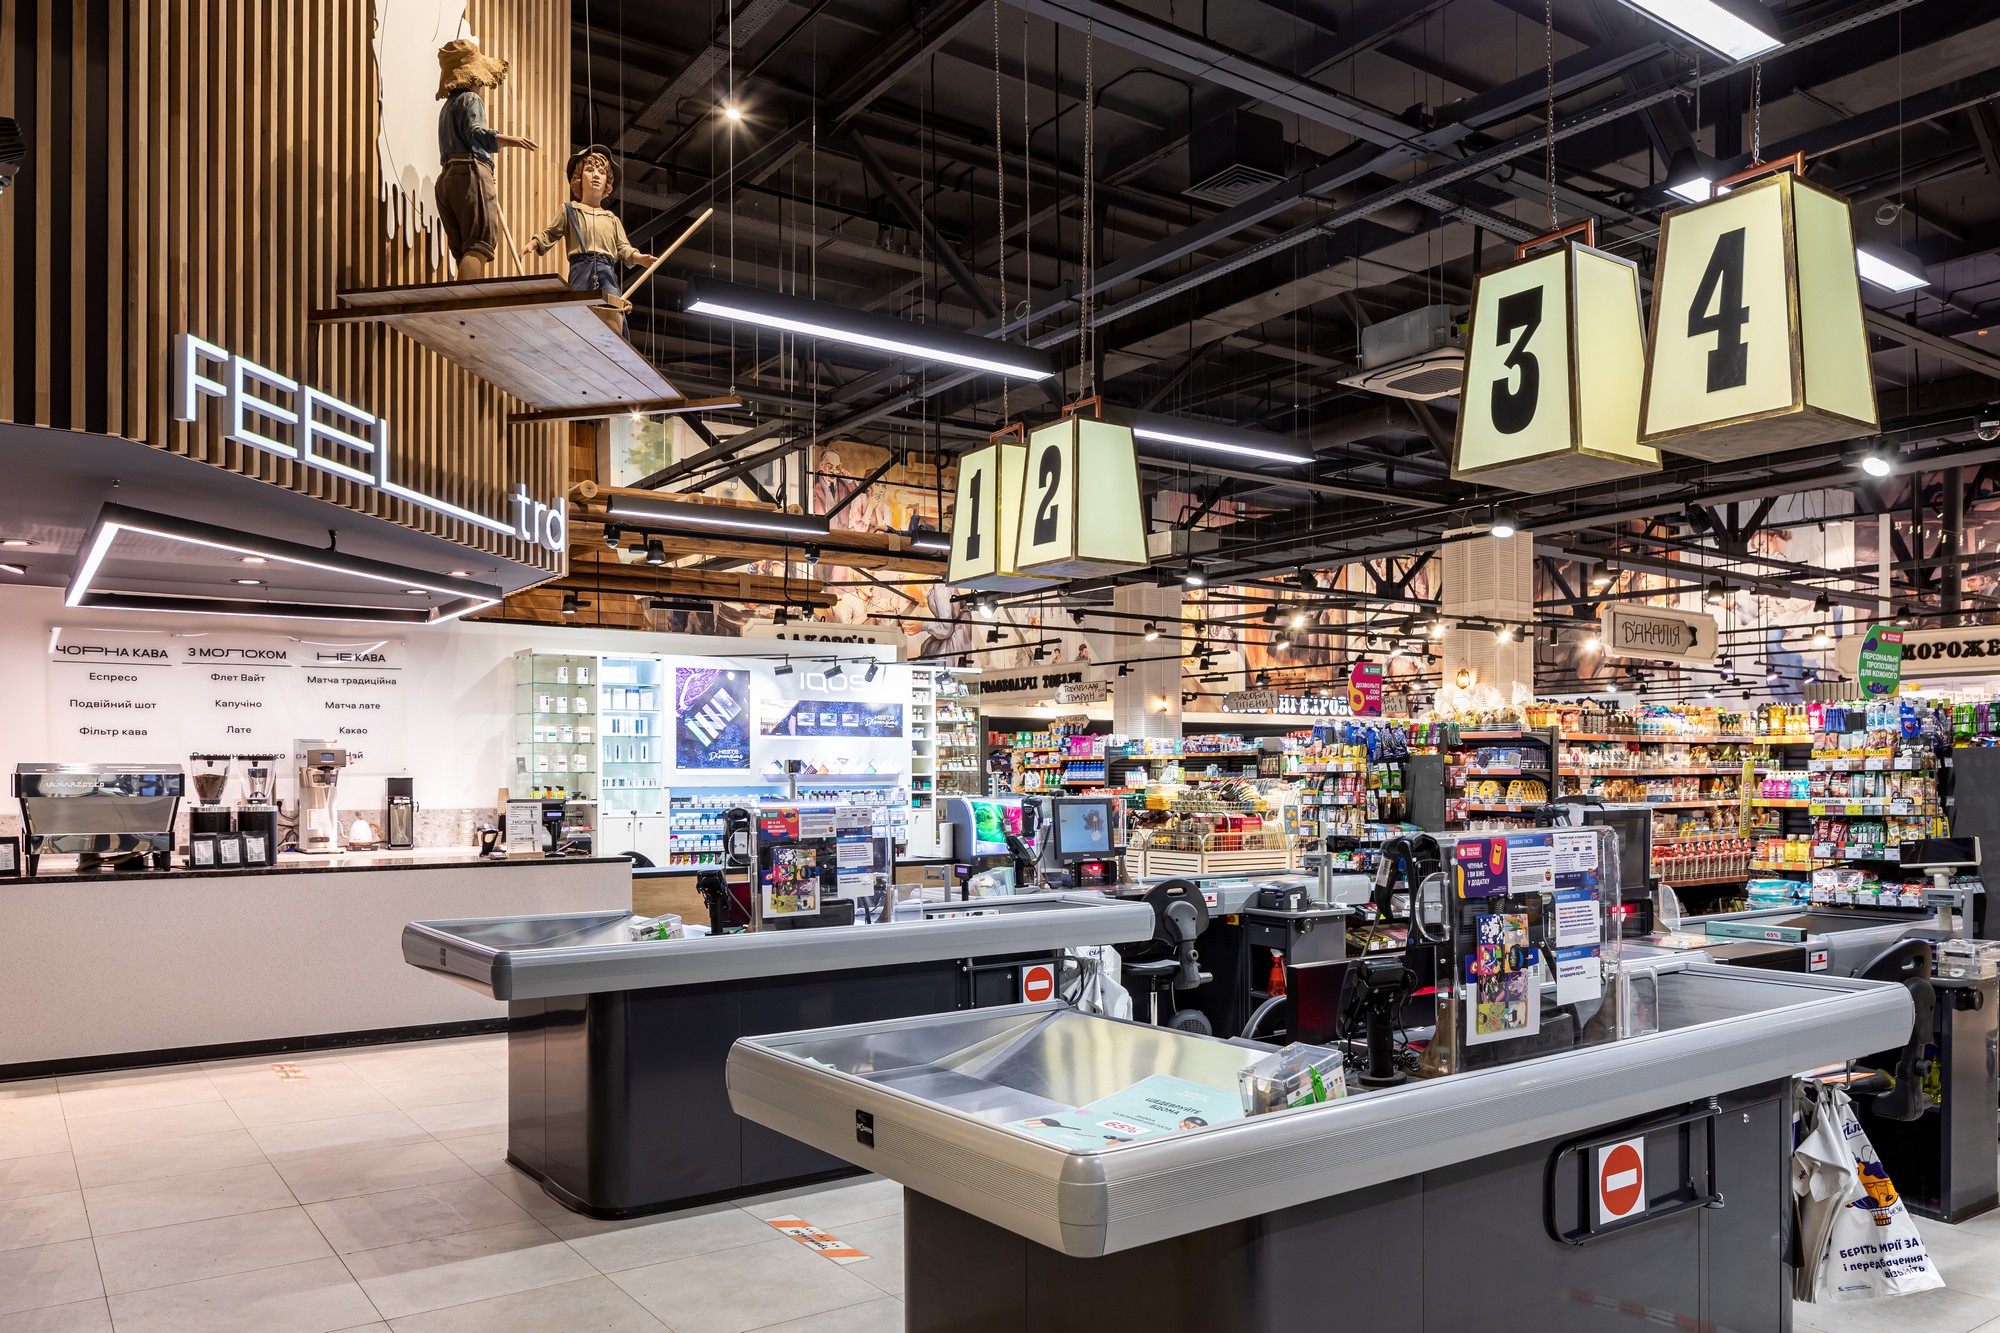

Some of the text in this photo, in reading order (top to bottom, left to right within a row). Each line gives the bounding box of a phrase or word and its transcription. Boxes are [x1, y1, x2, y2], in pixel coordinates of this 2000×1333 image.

[1687, 227, 1749, 393] 4
[1491, 285, 1543, 434] 3
[174, 333, 516, 535] FEEL
[1033, 445, 1061, 546] 2
[966, 469, 981, 561] 1
[1622, 621, 1680, 647] БАКАЛІЯ
[56, 645, 169, 658] ЧОРНА КАВА
[188, 648, 287, 659] З МОЛОКОМ
[1862, 652, 1899, 662] ПЕРСОНАЛЬНІ
[316, 652, 387, 663] НЕ КАВА
[1866, 661, 1899, 671] ПРОПОЗИЦІЇ
[89, 672, 138, 683] Еспресо
[210, 673, 266, 682] Флет Вайт
[1860, 669, 1898, 680] ДЛЯ КОЖНОГО
[307, 676, 397, 686] Матча традиційна
[800, 672, 867, 694] IQOS
[1066, 693, 1095, 702] ТВАРИН
[1233, 692, 1266, 702] ЗАСОБИ
[69, 699, 132, 709] Подвійний
[215, 699, 263, 709] Капучіно
[325, 701, 357, 710] Матча
[79, 727, 119, 737] Фільтр
[226, 725, 252, 734] Лате
[339, 727, 368, 735] Какао
[1145, 1097, 1202, 1115] ШЕДЕВРУЙТЕ
[1149, 1104, 1180, 1116] ВДОМА
[1105, 1121, 1142, 1134] 65%
[1879, 1239, 1903, 1254] МРІЇ
[1905, 1238, 1919, 1249] ЗА
[1850, 1254, 1924, 1273] передбачення
